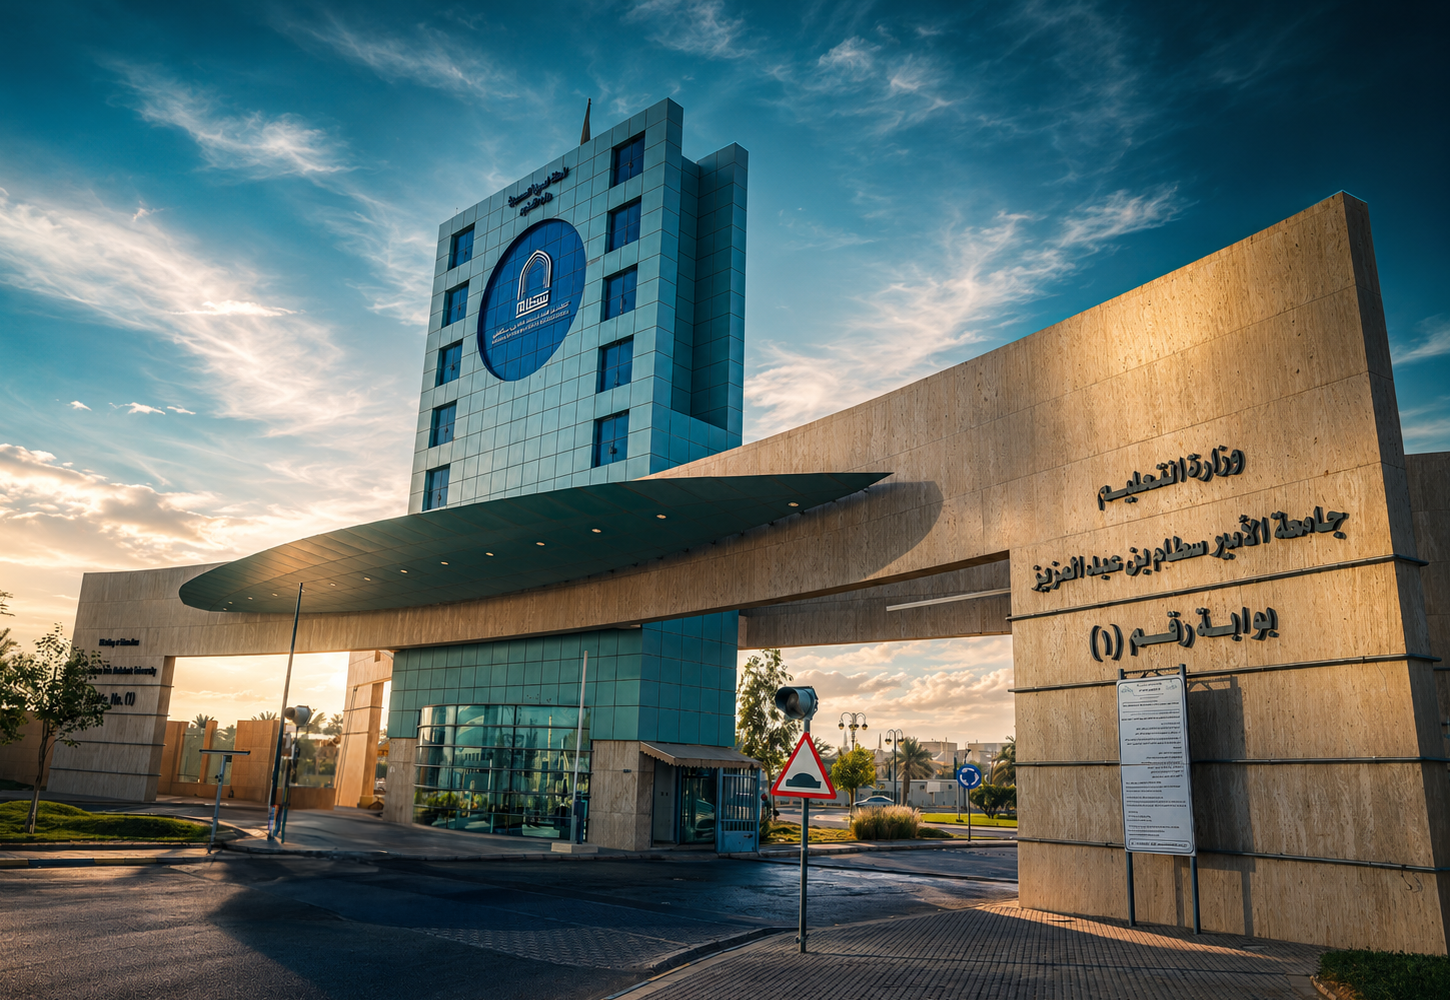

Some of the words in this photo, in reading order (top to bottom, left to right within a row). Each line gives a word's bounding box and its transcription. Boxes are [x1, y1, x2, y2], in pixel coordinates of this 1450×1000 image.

[1187, 445, 1246, 482] وزارة
[1097, 456, 1187, 511] التعليم
[1270, 505, 1349, 540] جامعة
[1086, 555, 1124, 580] عبد
[1126, 546, 1152, 577] بن
[1153, 535, 1209, 572] سطام
[1031, 555, 1085, 593] العزيز
[1129, 611, 1196, 656] رقم
[1195, 607, 1280, 642] بوابة
